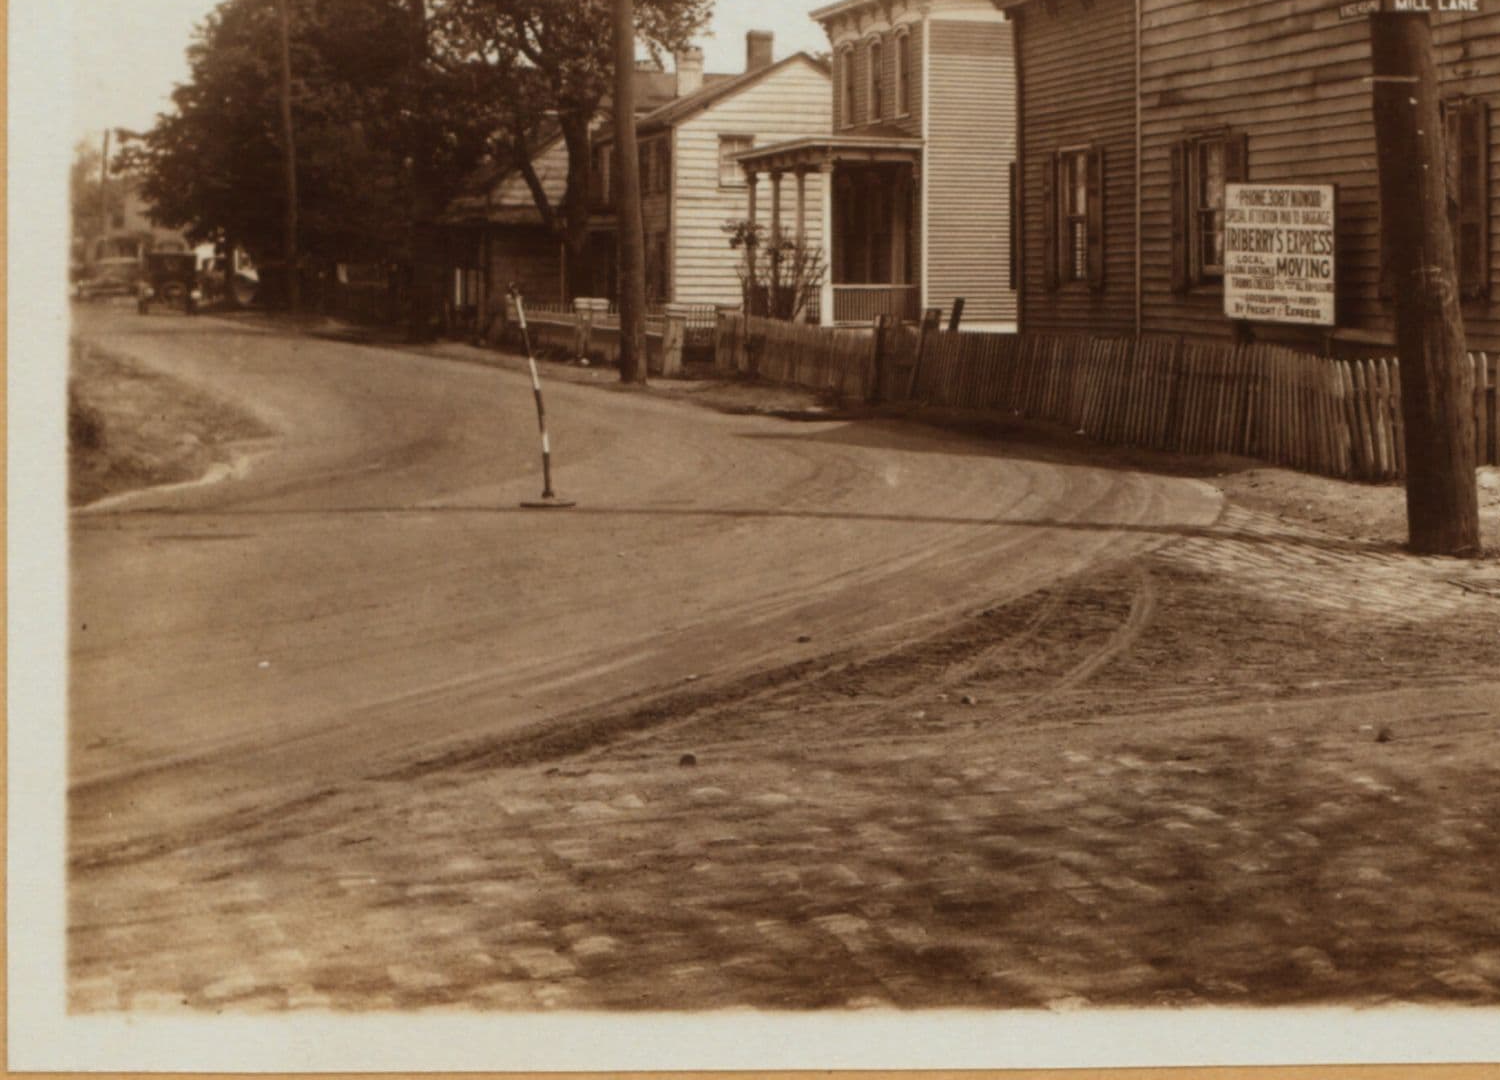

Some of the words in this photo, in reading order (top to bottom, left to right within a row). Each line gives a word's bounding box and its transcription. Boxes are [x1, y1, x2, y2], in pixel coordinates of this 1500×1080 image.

[1239, 189, 1264, 206] PHONE
[1286, 230, 1333, 256] EXPRESS
[1237, 255, 1265, 265] LOCAL
[1277, 257, 1330, 279] MOVING
[1234, 303, 1244, 314] BY
[1246, 304, 1276, 315] FREIGHT
[1285, 305, 1321, 318] EXPRESS
